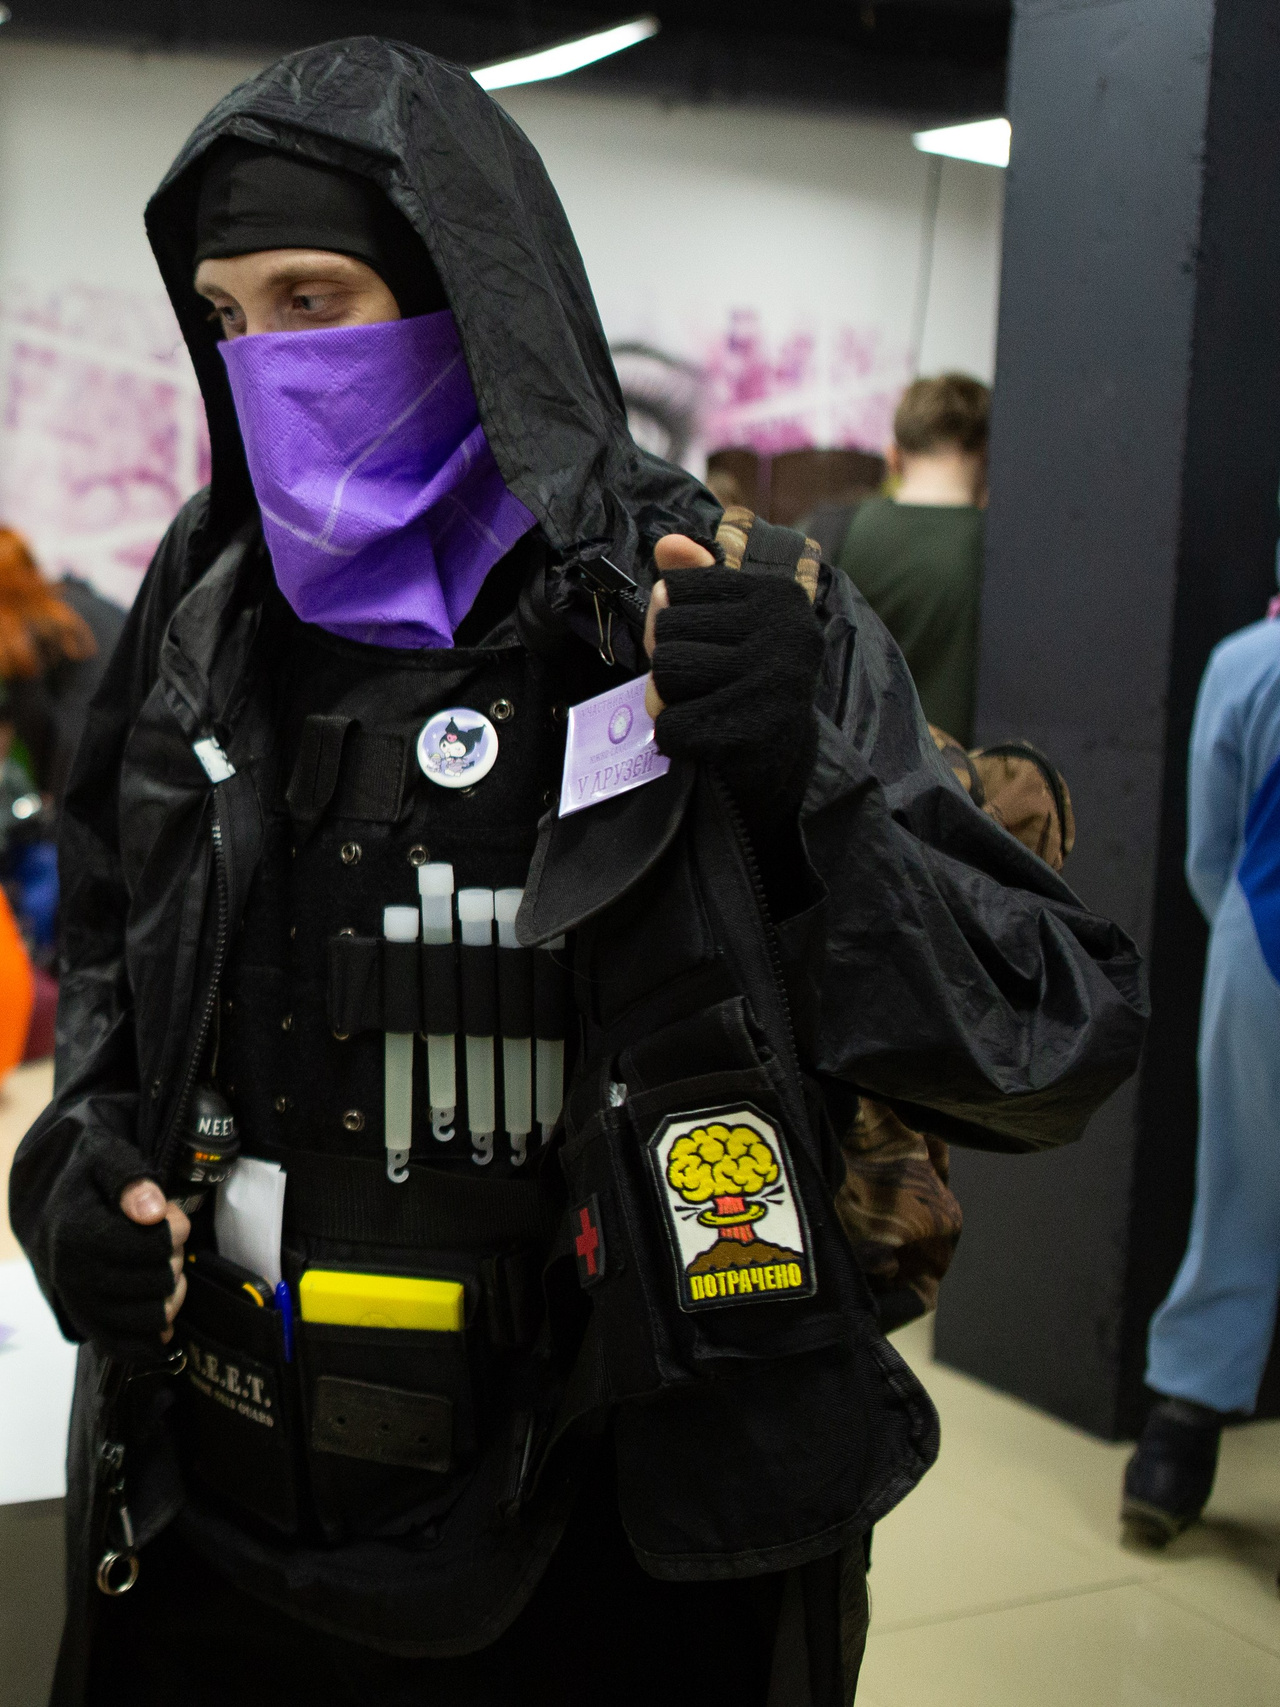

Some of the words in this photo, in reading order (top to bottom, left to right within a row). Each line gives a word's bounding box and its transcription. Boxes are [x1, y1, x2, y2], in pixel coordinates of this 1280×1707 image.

[577, 775, 589, 800] У
[591, 745, 659, 798] ДРУЗЕЙ
[689, 1263, 802, 1300] ПОТРАЧЕНО
